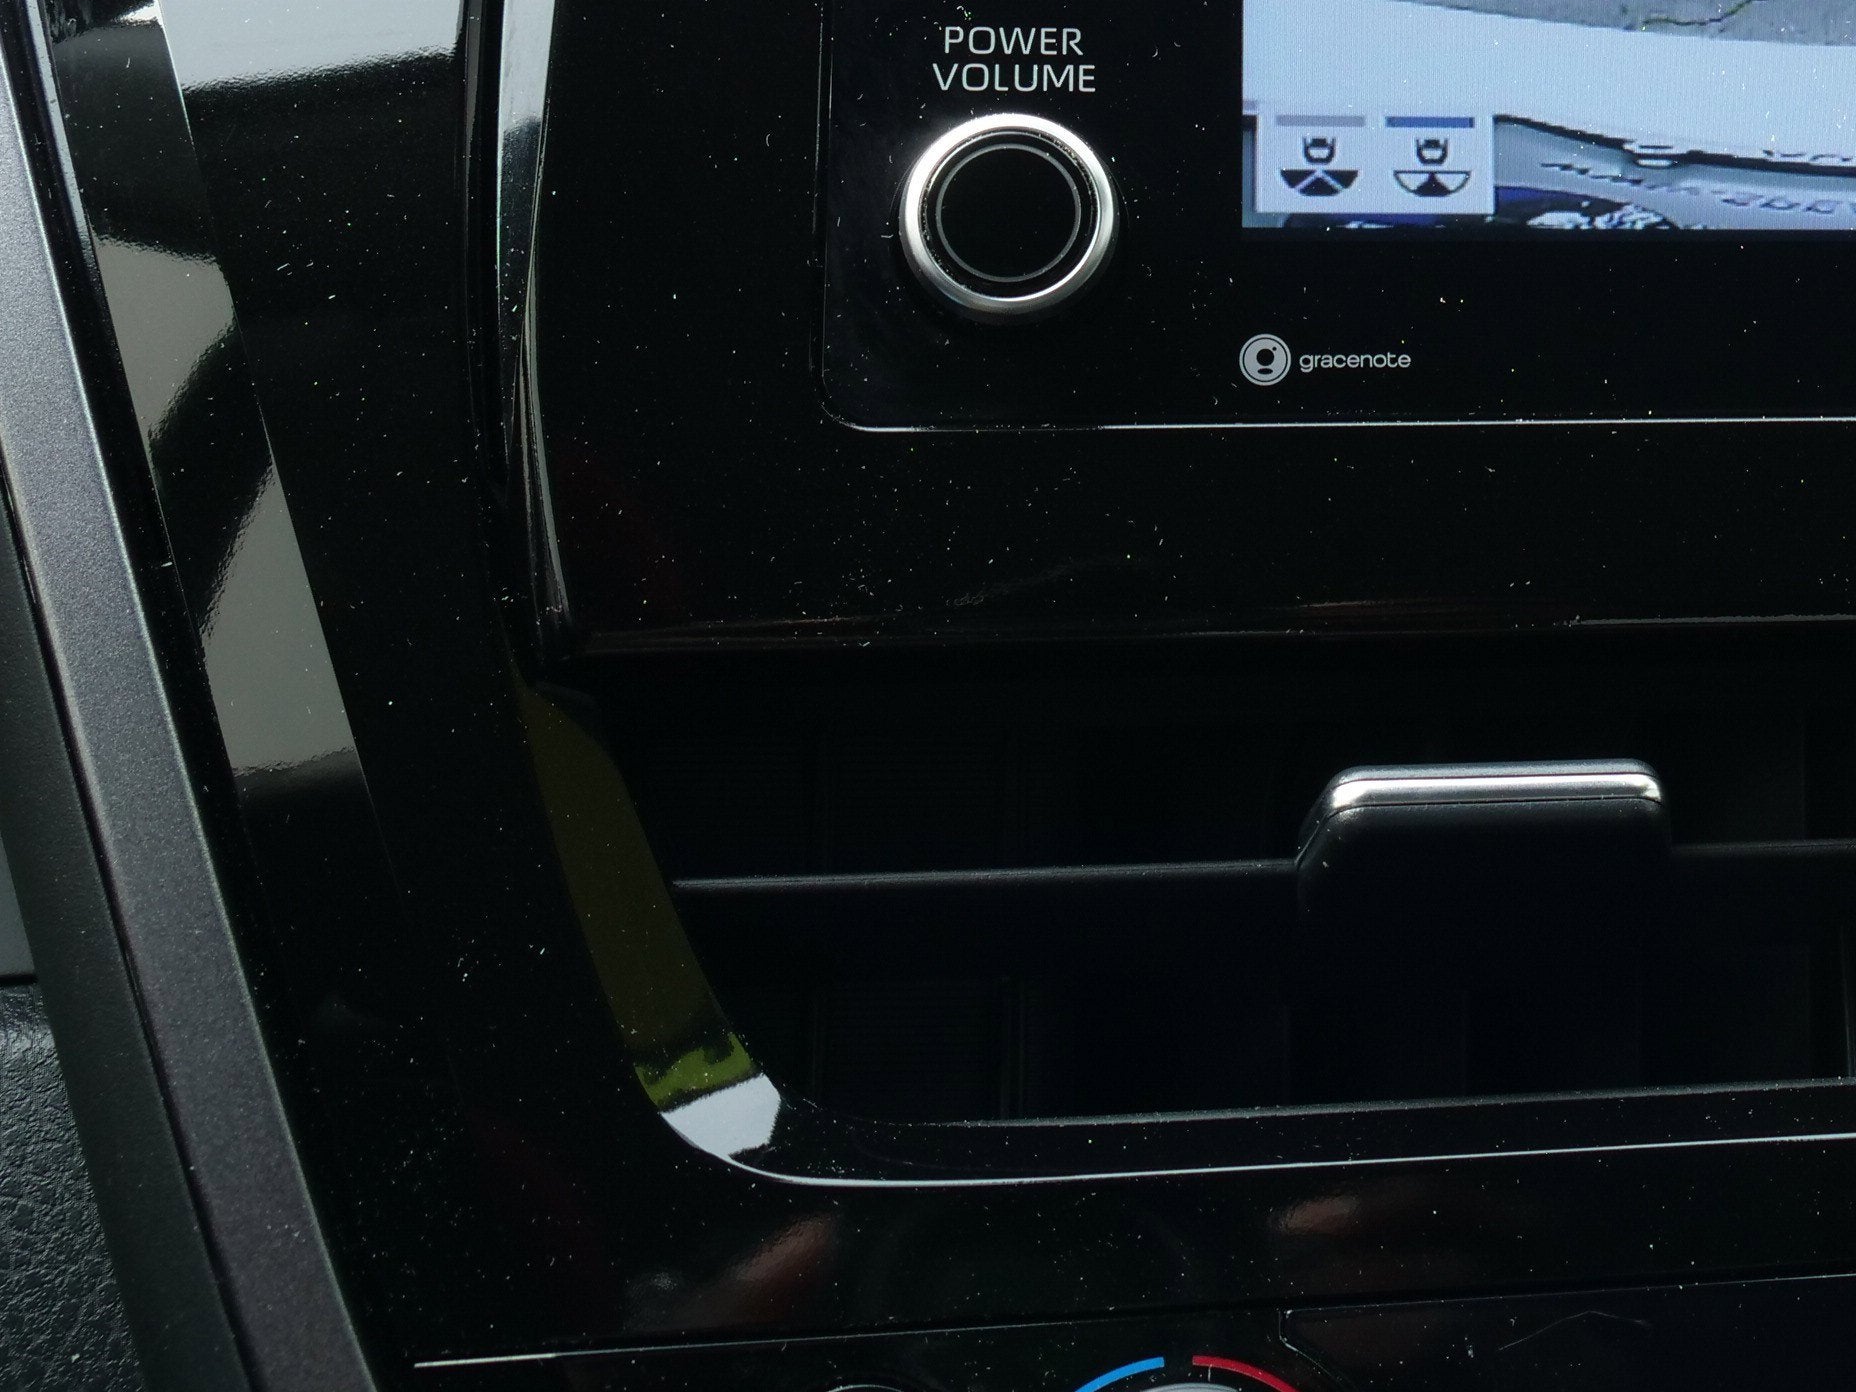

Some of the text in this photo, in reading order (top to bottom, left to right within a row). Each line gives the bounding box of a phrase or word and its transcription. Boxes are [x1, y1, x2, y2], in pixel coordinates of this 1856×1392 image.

[944, 26, 1084, 56] POWER
[932, 62, 1096, 93] VOLUME
[1299, 351, 1412, 374] gracenote
